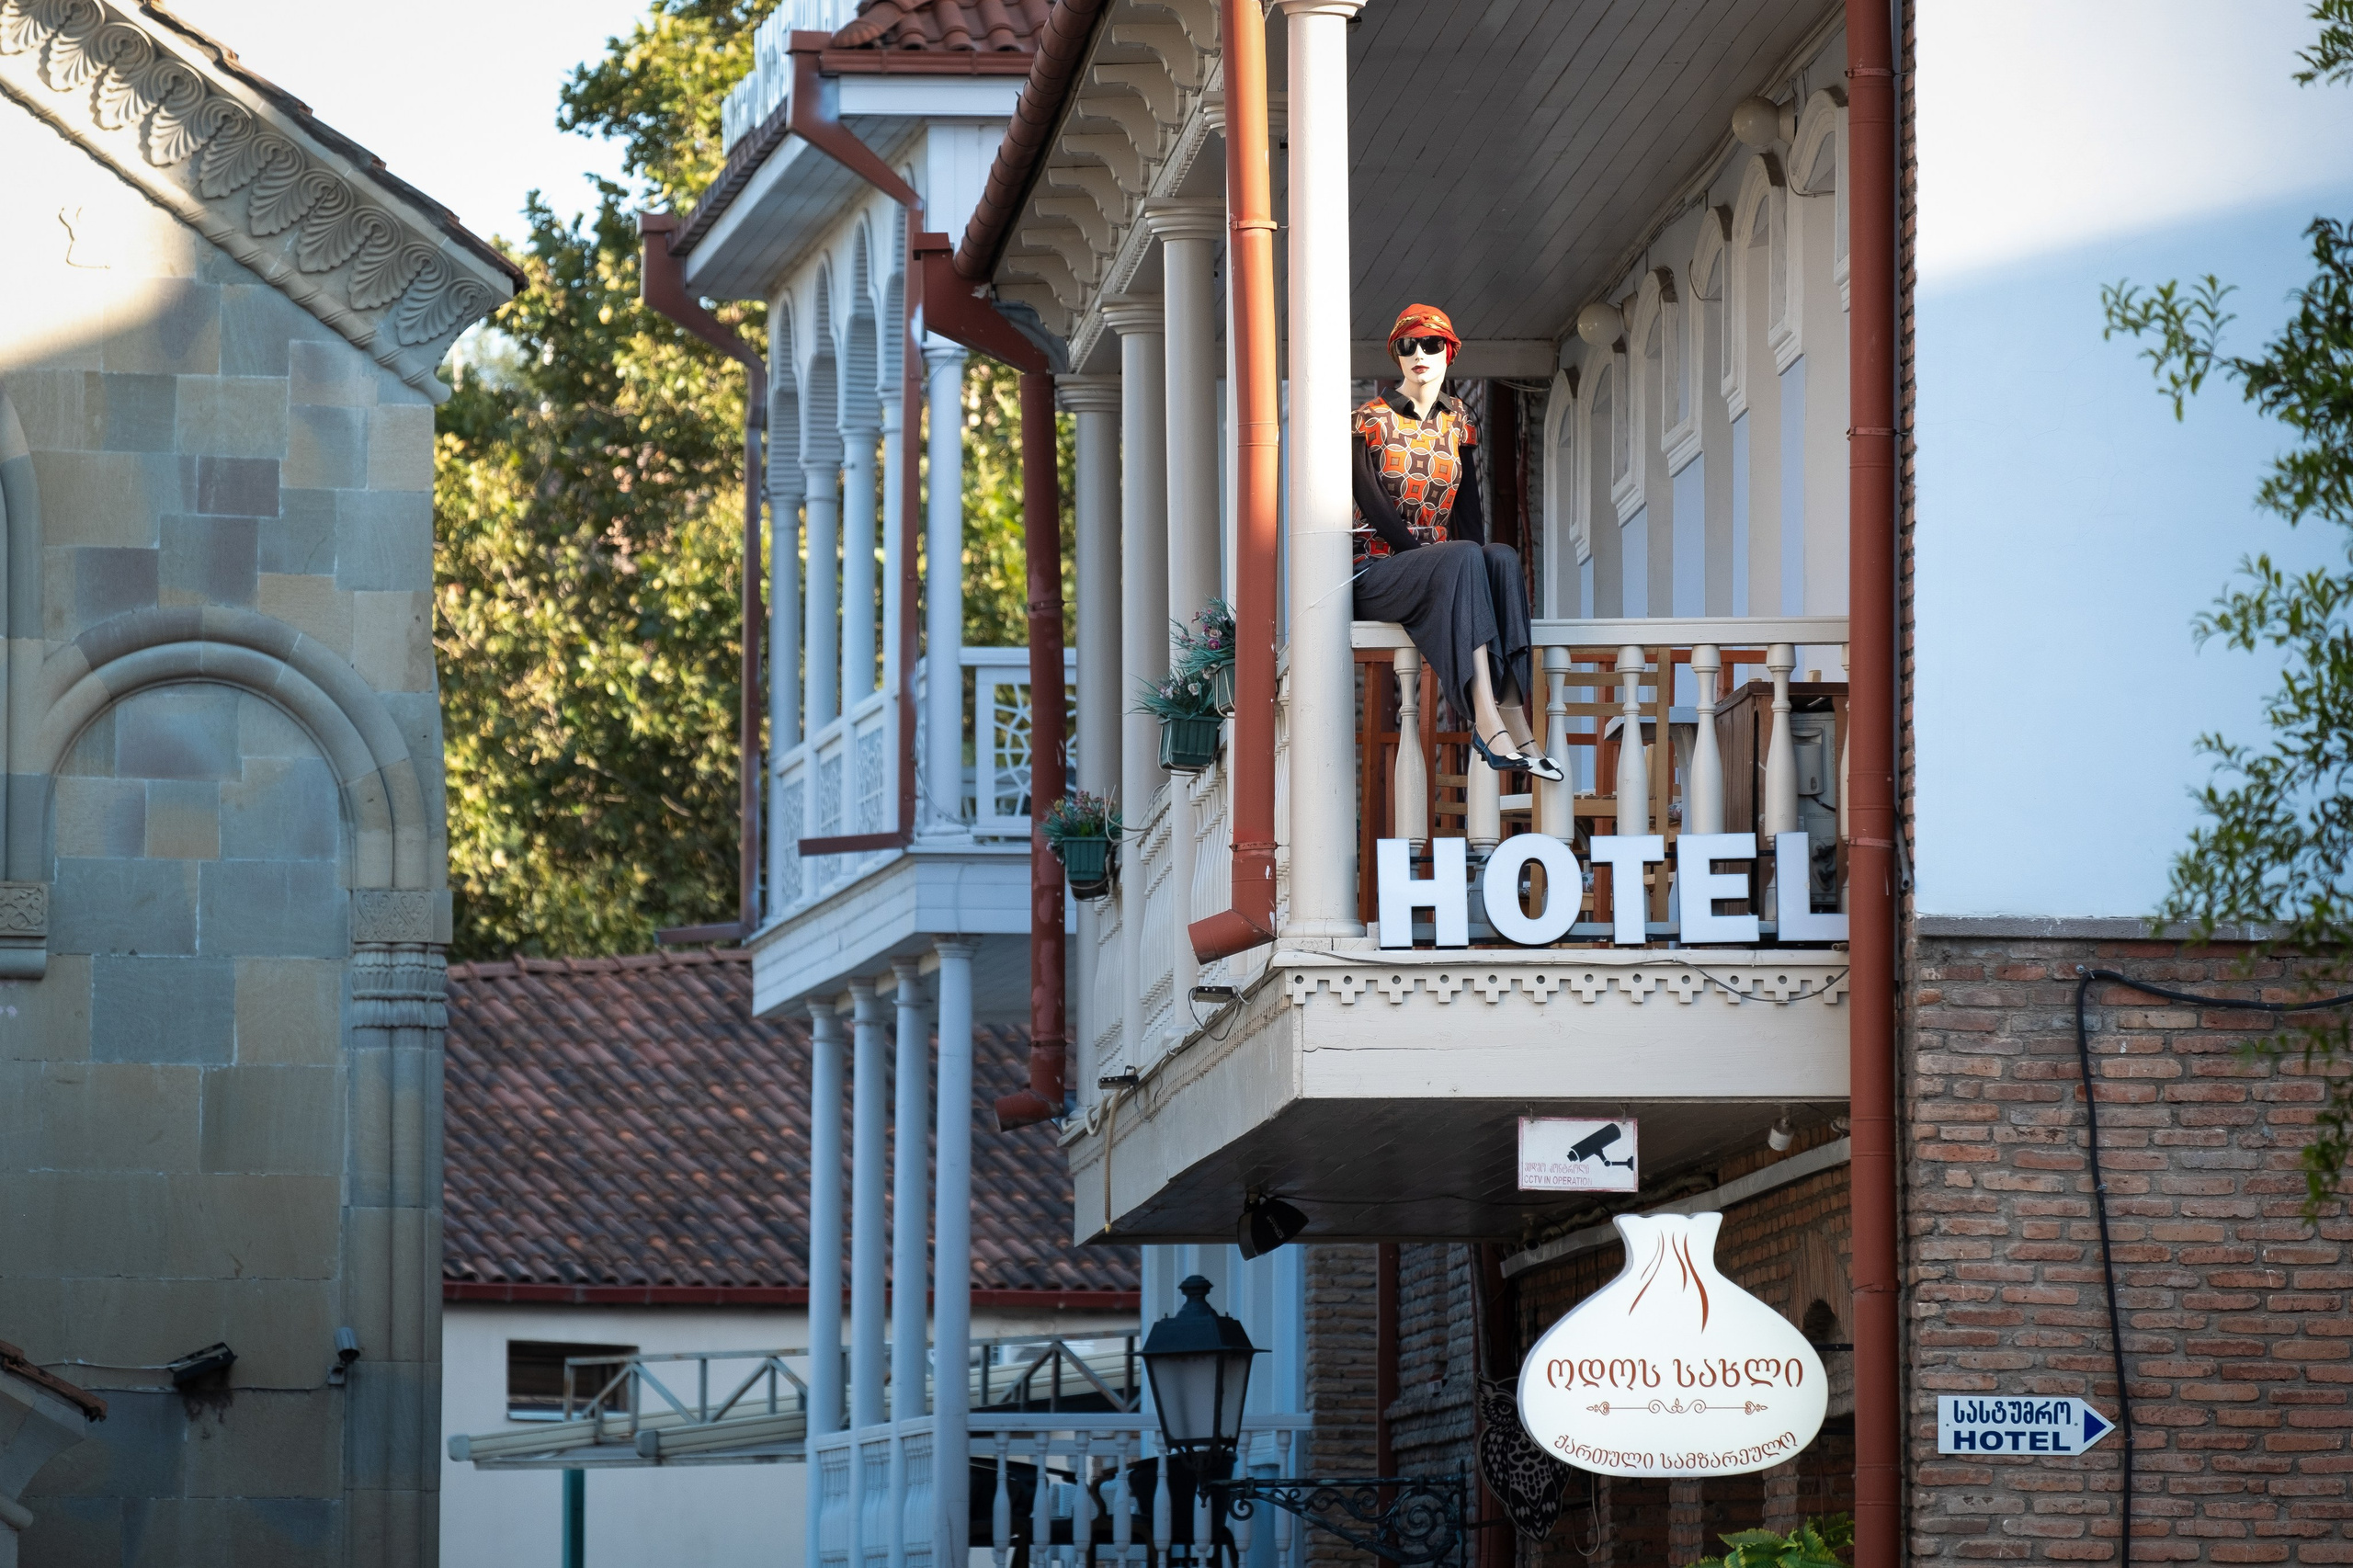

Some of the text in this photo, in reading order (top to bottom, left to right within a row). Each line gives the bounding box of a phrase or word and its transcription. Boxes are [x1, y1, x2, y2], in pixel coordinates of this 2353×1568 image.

[1377, 832, 1849, 948] HOTEL
[1524, 1175, 1593, 1186] CCTV IN OPERATION
[1547, 1358, 1803, 1391] ოდოს სახლი
[1953, 1400, 2071, 1426] სასტუმრო
[1554, 1431, 1798, 1470] ქართული სამზარეულო
[1953, 1430, 2071, 1451] HOTEL
